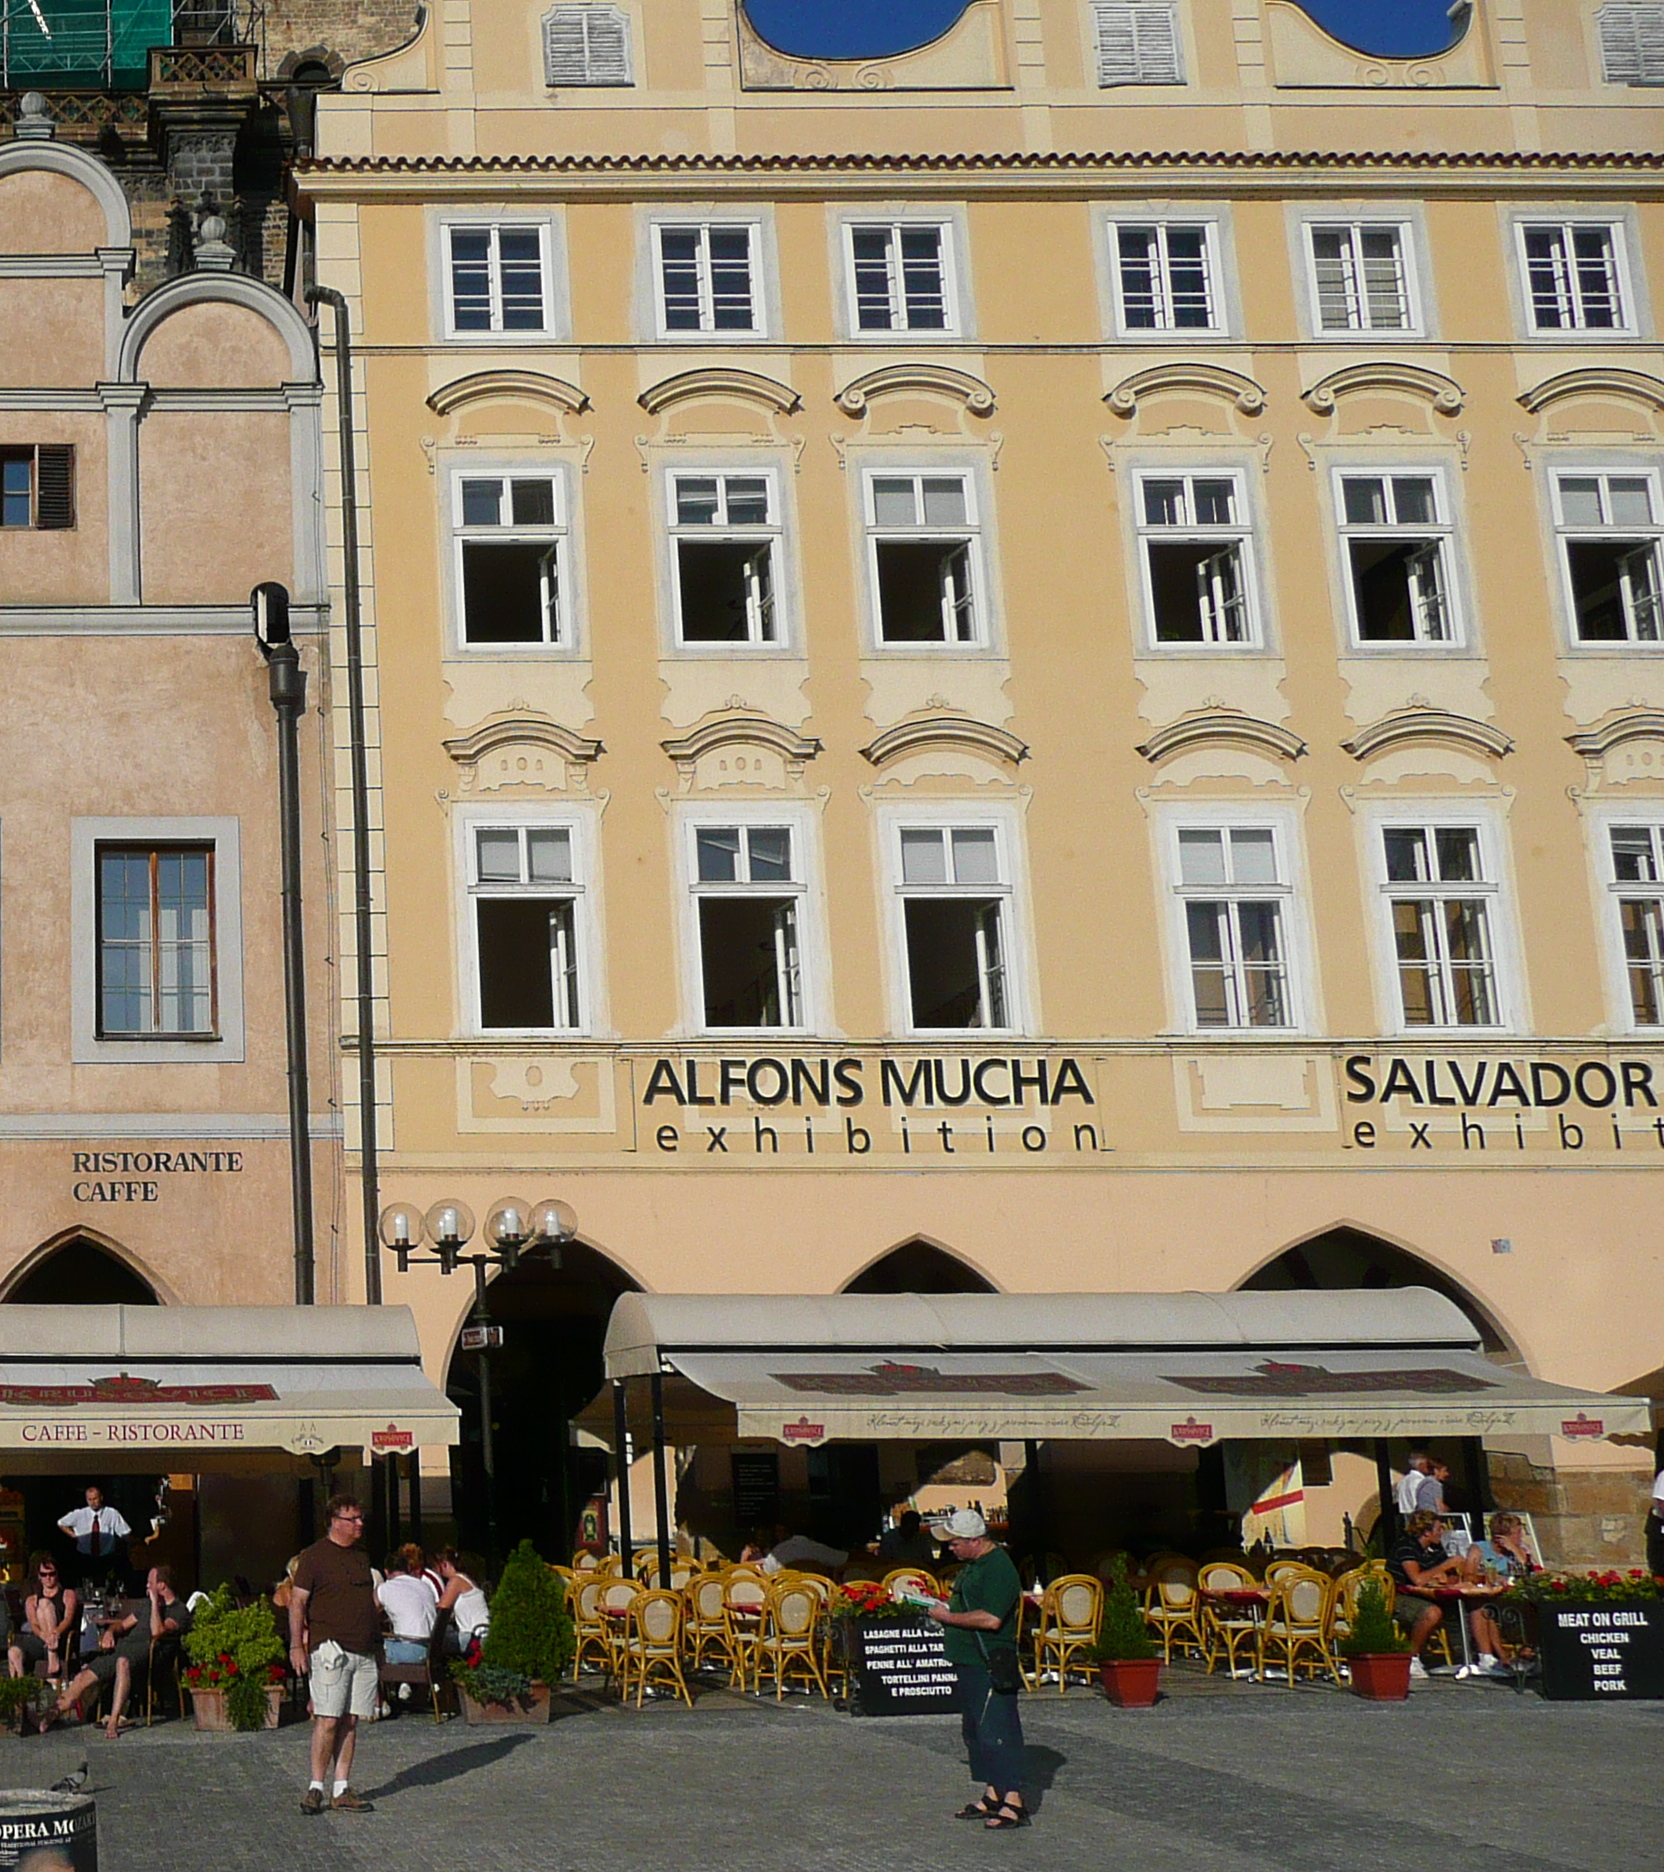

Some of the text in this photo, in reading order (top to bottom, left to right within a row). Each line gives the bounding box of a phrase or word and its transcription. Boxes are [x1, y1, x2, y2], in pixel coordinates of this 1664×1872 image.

[642, 1058, 1096, 1107] ALFONS MUCHA
[1344, 1055, 1659, 1108] SALVADOR
[655, 1116, 1099, 1154] exhibition
[72, 1152, 244, 1173] RISTORANTE
[73, 1181, 159, 1202] CAFFE
[22, 1424, 87, 1442] CAFFE
[106, 1423, 244, 1441] RISTORANTE
[1557, 1611, 1649, 1627] MEAT ON GRILL
[863, 1629, 900, 1639] LASAGNE
[902, 1628, 922, 1638] ALLA
[1580, 1632, 1630, 1644] CHICKEN
[865, 1644, 906, 1655] SPAGHETTI
[908, 1643, 928, 1653] ALLA
[1591, 1648, 1622, 1659] VEAL
[866, 1660, 895, 1670] PENNE
[1593, 1664, 1622, 1675] BEEF
[881, 1674, 930, 1685] TORTELLINI
[1593, 1679, 1627, 1691] PORK
[891, 1686, 952, 1697] E PROSCIUTTO
